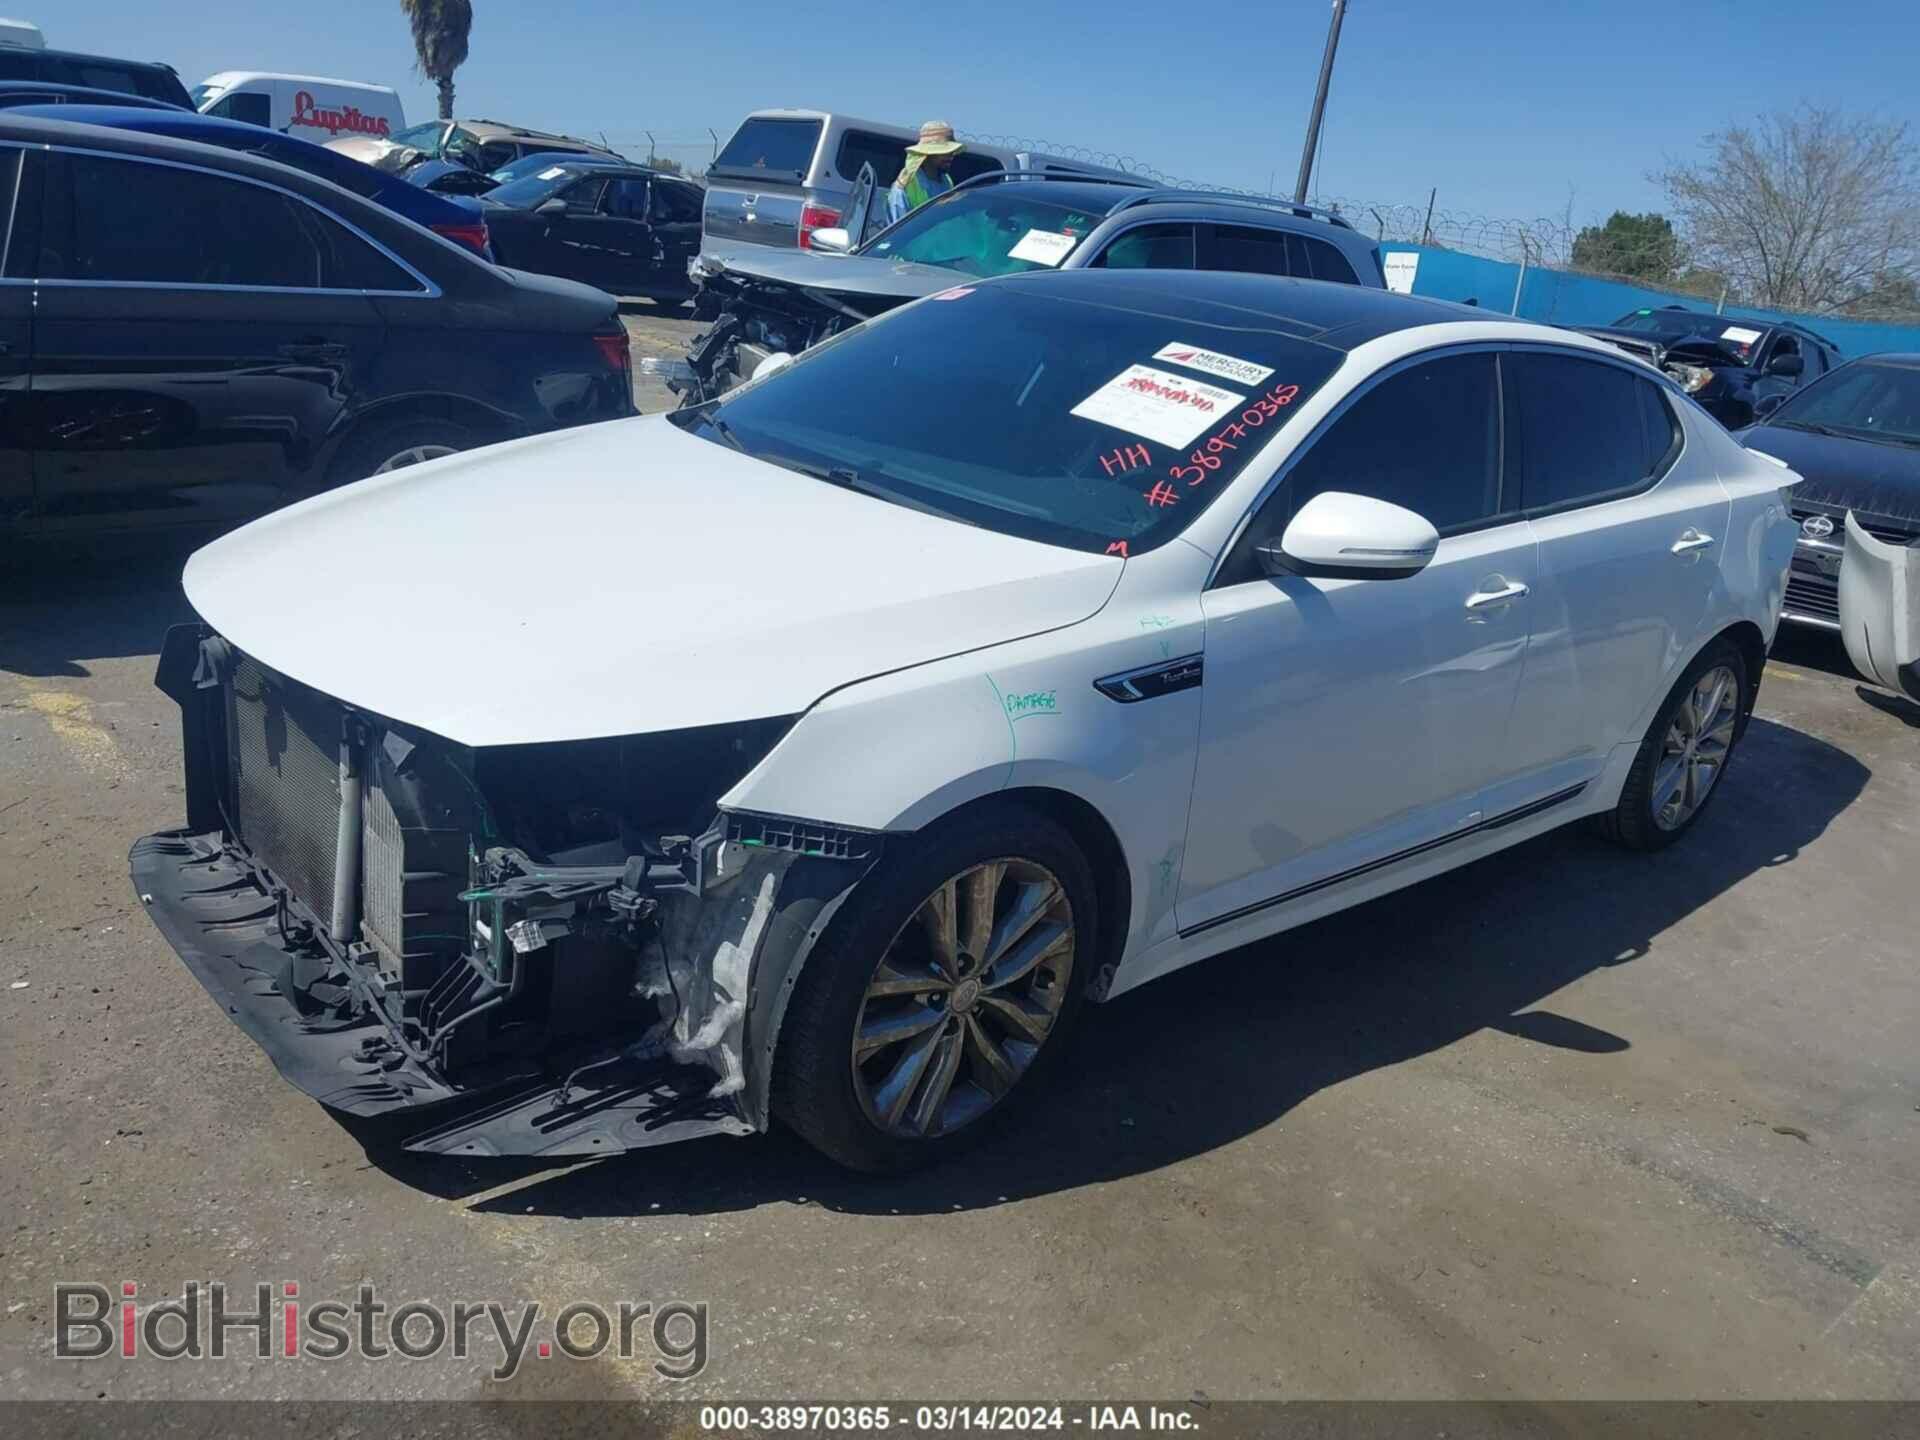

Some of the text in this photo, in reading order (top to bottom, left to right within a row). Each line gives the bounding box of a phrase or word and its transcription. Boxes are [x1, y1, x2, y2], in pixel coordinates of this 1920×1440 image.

[291, 90, 390, 136] Lupitas
[1191, 359, 1261, 381] INSURANCE
[1196, 352, 1268, 376] MERCURY
